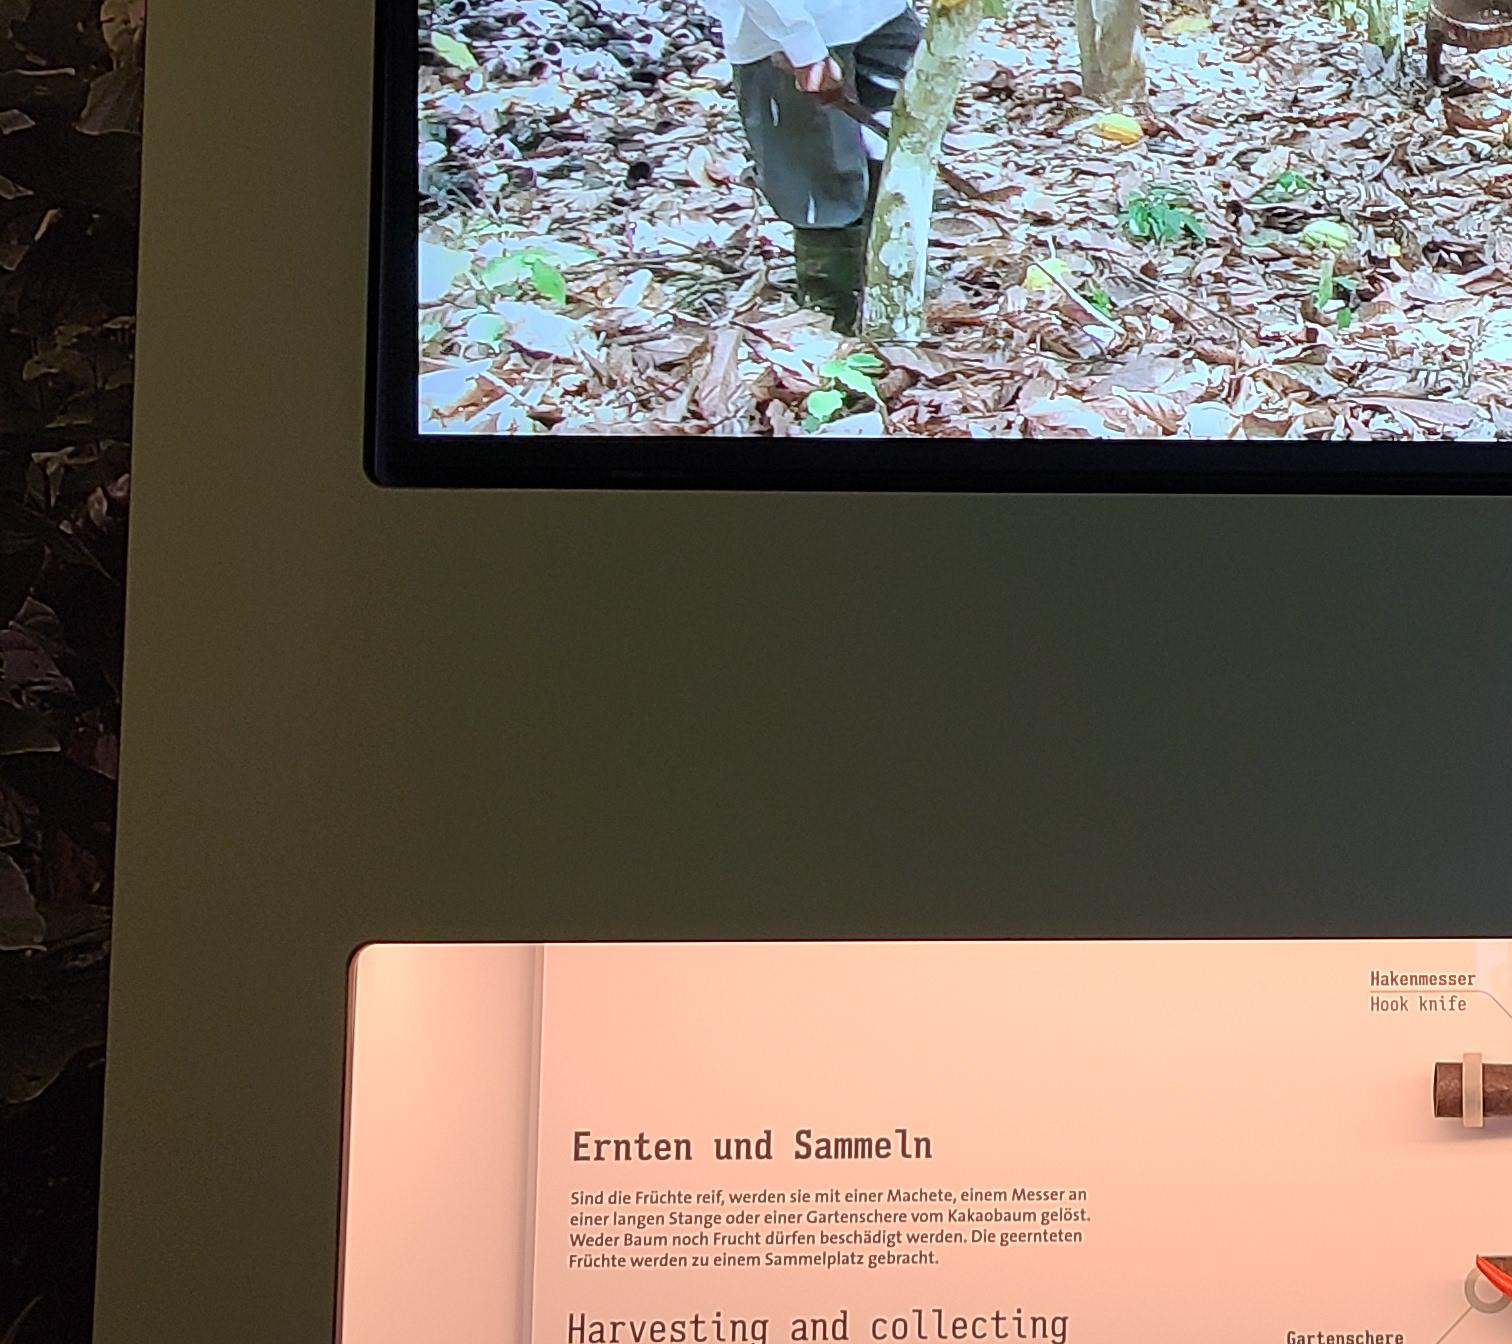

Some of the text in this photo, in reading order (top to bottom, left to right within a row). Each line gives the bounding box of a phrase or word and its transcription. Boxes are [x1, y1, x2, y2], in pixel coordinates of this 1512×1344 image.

[1371, 970, 1476, 986] Hakenmesser
[1371, 995, 1466, 1012] Hook knife
[574, 1129, 932, 1161] Ernten und Sammeln
[571, 1187, 1087, 1206] Sind die Früchte reif, werden sie mit einer Machete, einem Messer an
[570, 1207, 1090, 1229] einer langen Stange oder einer Gartenschere vom Kakaobaum gelöst.
[570, 1229, 1082, 1248] Weder Baum noch Frucht dürfen beschädigt werden. Die geernteten
[569, 1250, 939, 1270] Früchte werden zu einem Sammelplatz gebracht.
[791, 1310, 849, 1341] and
